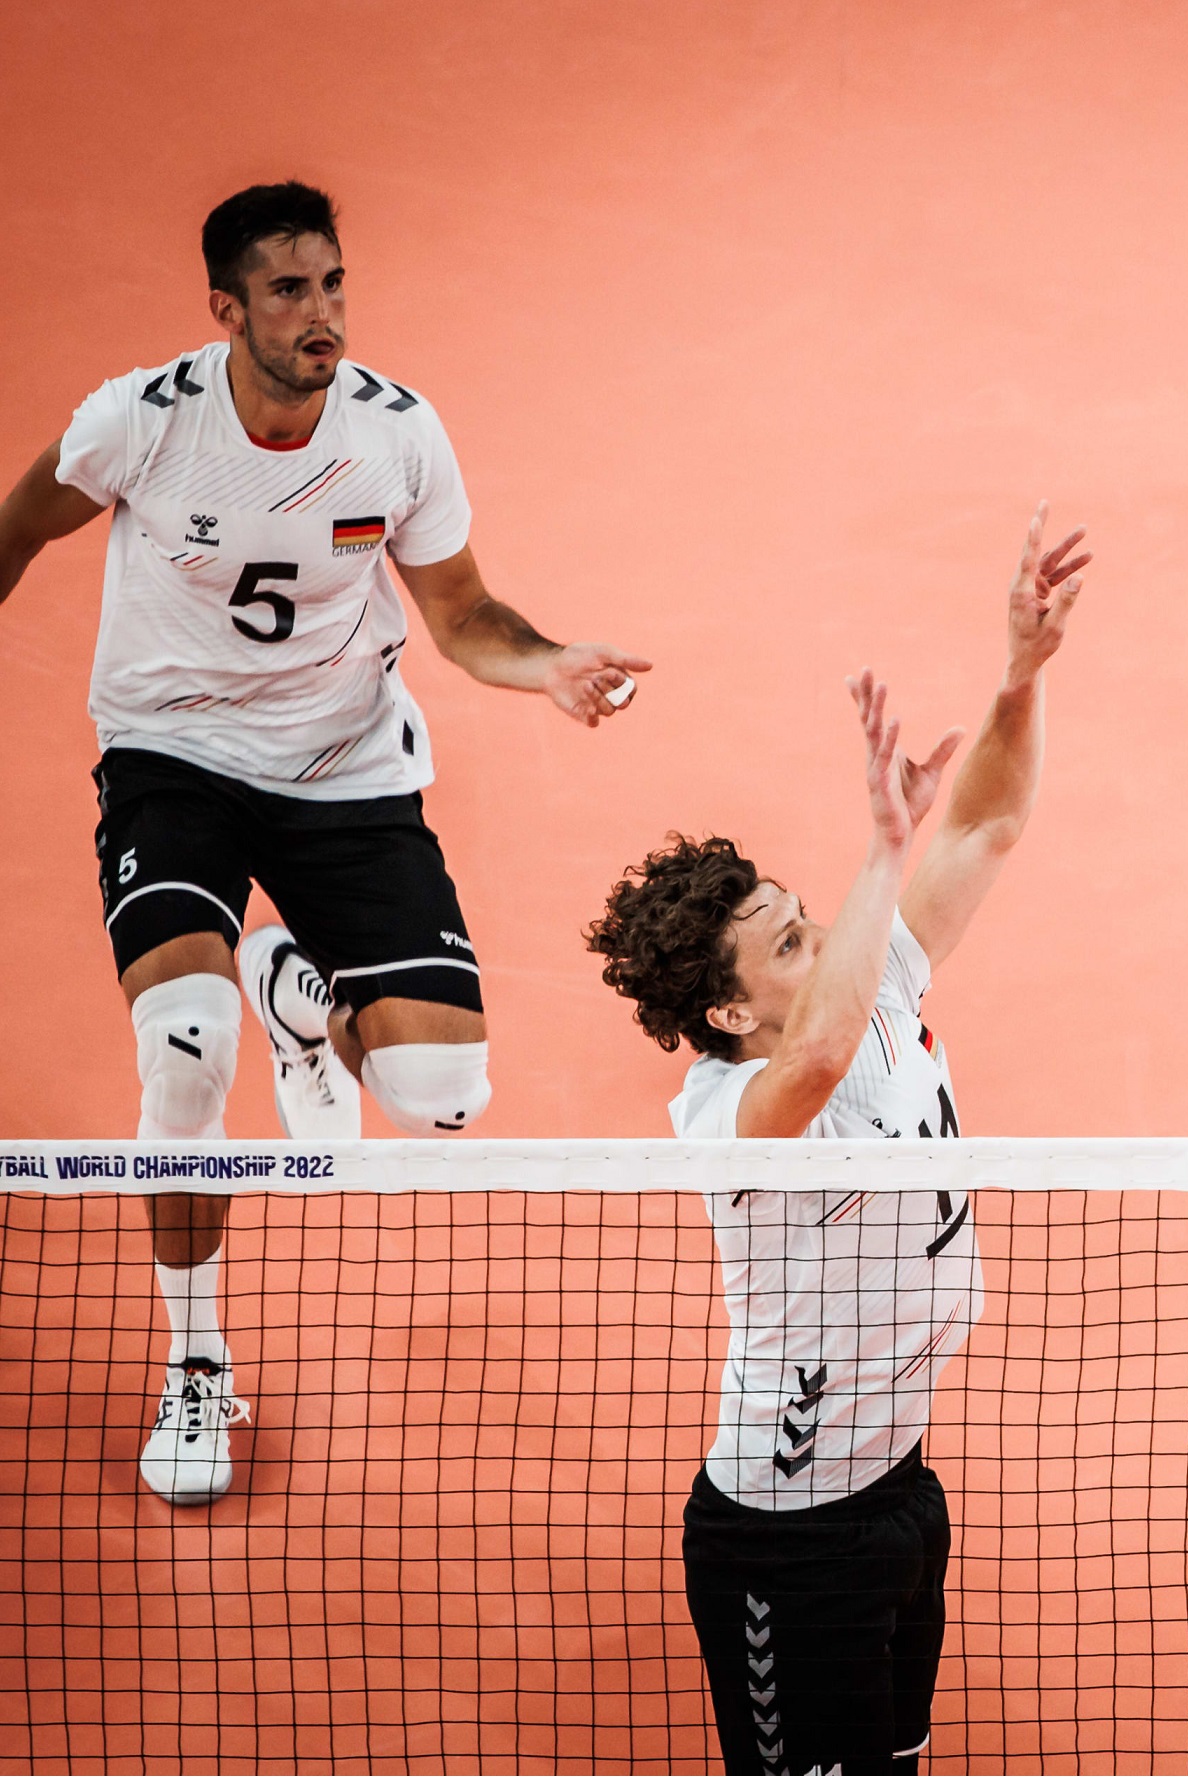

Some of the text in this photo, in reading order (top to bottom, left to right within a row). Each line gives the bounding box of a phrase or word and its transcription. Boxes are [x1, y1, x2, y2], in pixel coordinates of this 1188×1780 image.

[185, 533, 220, 547] hummel
[228, 561, 299, 644] 5
[118, 848, 137, 884] 5
[55, 1155, 126, 1179] WORLD
[133, 1155, 276, 1180] CHAMPIONSHIP
[283, 1154, 334, 1179] 2022
